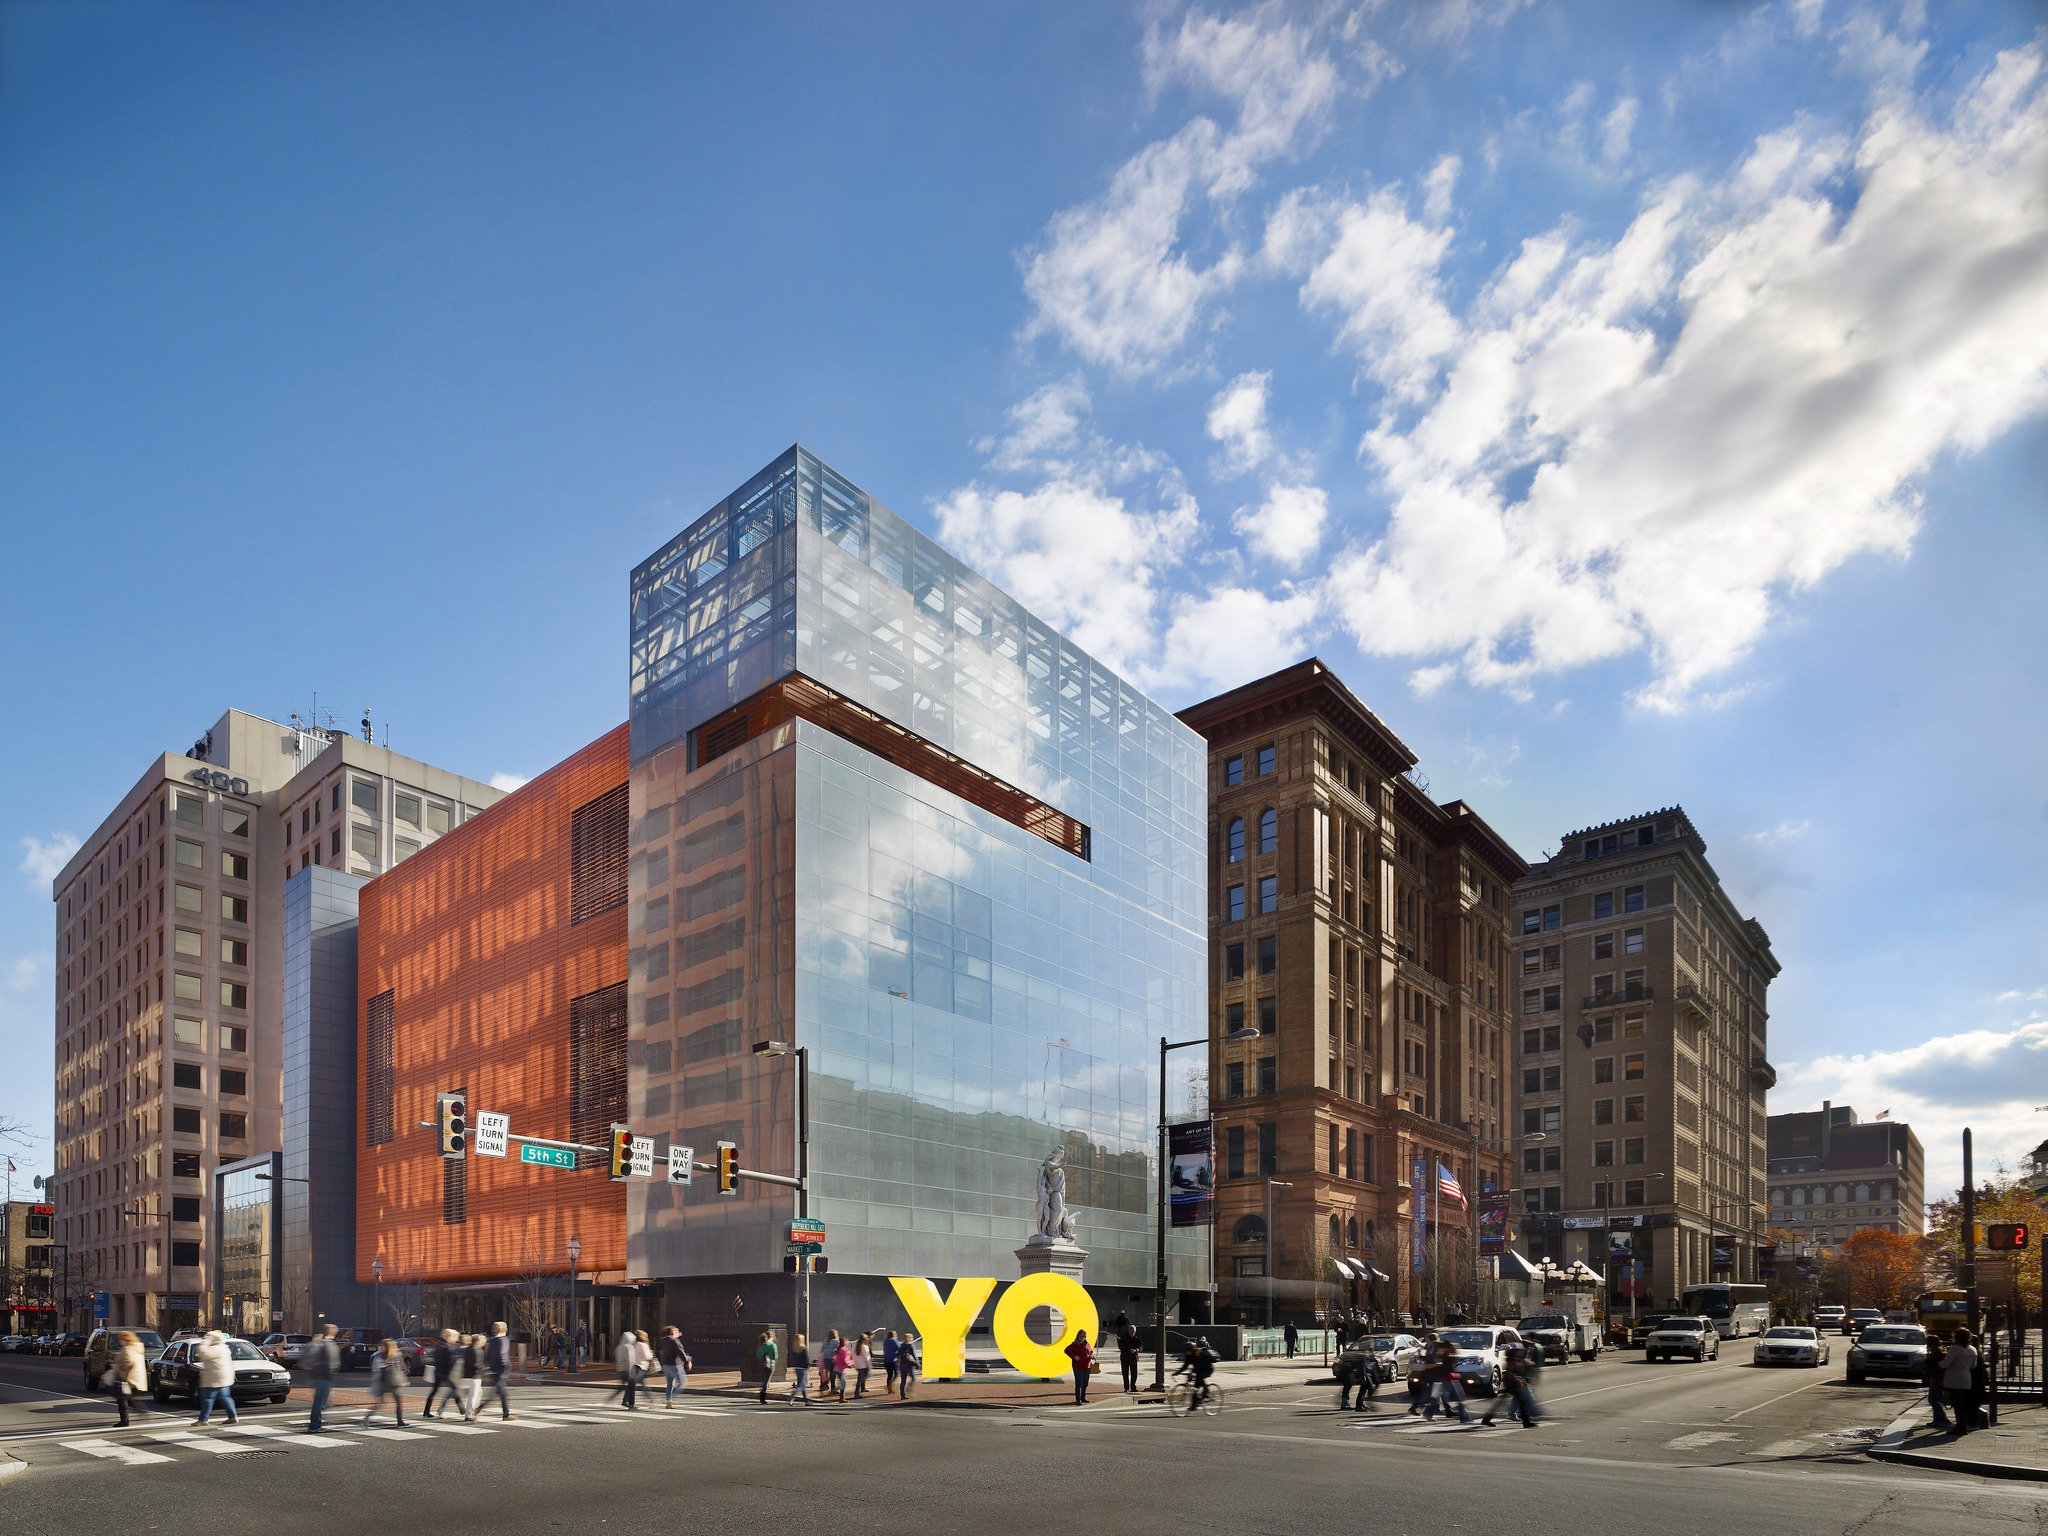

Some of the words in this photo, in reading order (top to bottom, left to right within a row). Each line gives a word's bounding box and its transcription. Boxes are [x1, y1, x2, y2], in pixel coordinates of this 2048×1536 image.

[192, 767, 249, 796] 400
[482, 1116, 504, 1128] LEFT
[481, 1128, 504, 1140] TURN
[478, 1140, 504, 1152] SIGNAL
[632, 1141, 650, 1150] LEFT
[528, 1149, 550, 1162] 5th
[555, 1153, 569, 1165] St
[673, 1148, 689, 1159] ONE
[672, 1159, 689, 1169] WAY
[33, 1204, 55, 1215] FOX
[2015, 1228, 2024, 1245] 2
[888, 1272, 1099, 1379] YO
